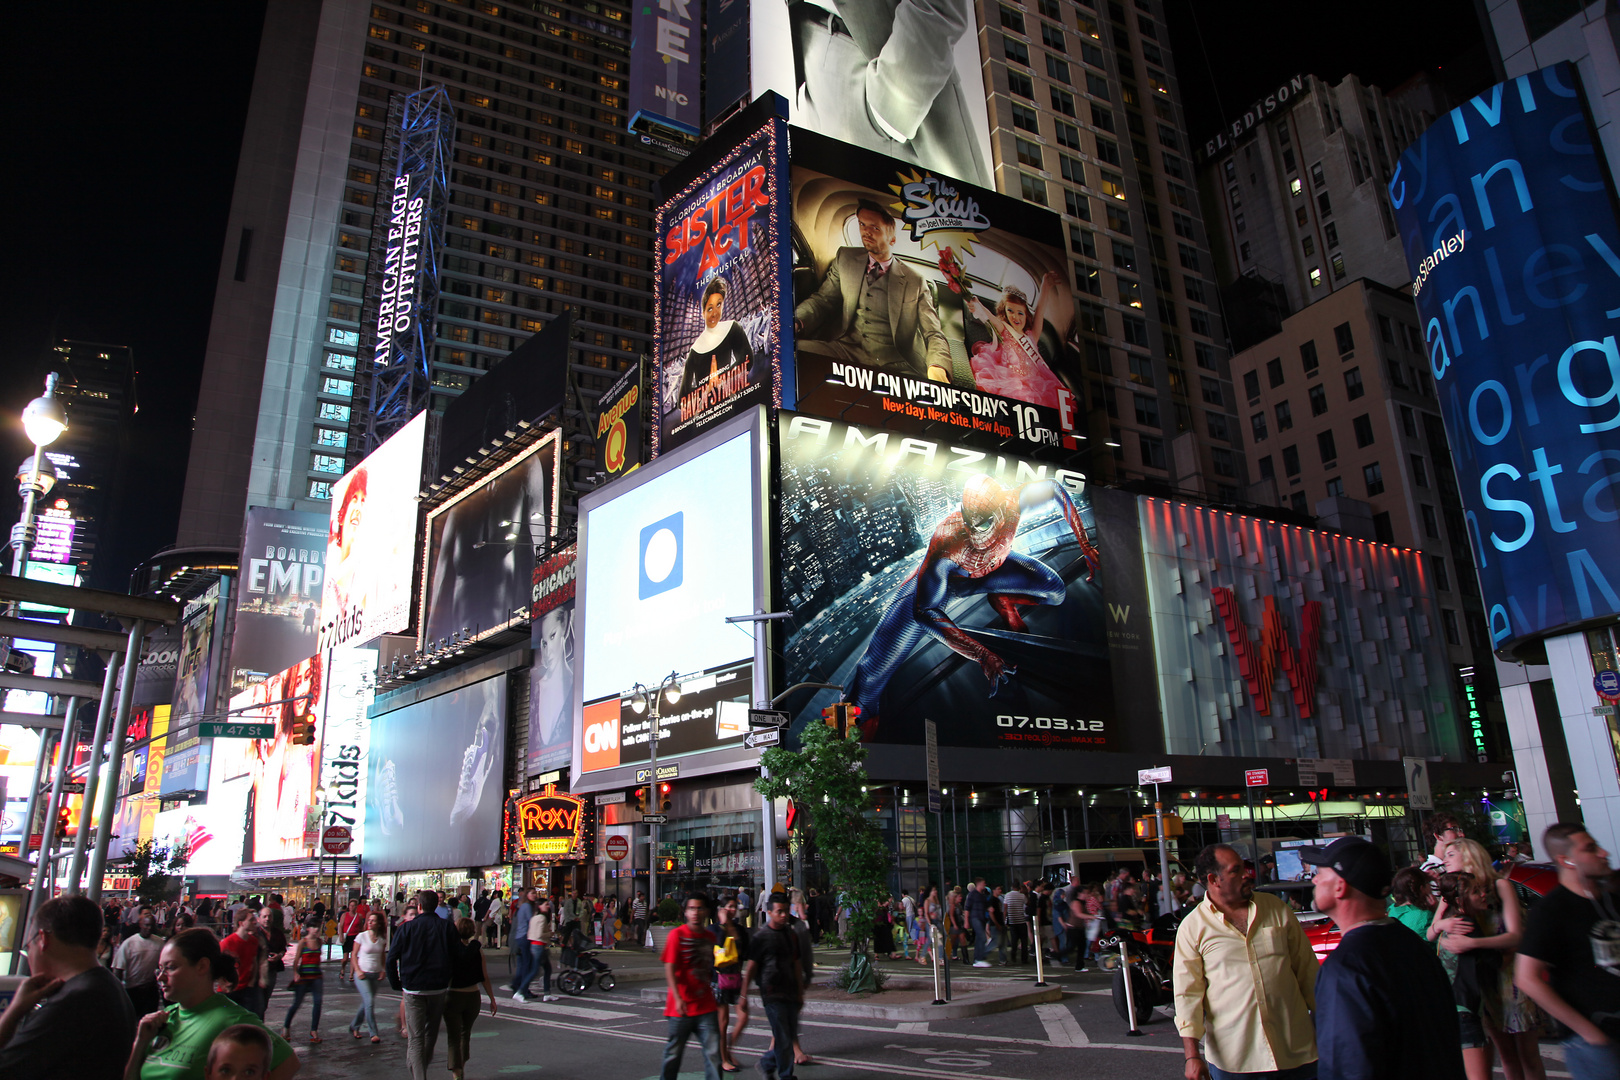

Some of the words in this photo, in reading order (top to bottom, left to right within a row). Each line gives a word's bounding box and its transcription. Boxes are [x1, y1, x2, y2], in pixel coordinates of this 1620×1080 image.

[655, 85, 689, 106] NYC
[1231, 74, 1303, 138] EDISON
[669, 185, 715, 227] GLORIOUSLY
[716, 150, 763, 191] BROADWAY
[903, 181, 982, 221] Soup
[924, 177, 958, 198] The
[664, 165, 769, 265] SISTER
[927, 218, 939, 229] Joel
[939, 218, 963, 227] McHale
[696, 204, 756, 281] ACT
[374, 246, 402, 366] AMERICAN
[388, 173, 410, 241] EAGLE
[394, 196, 424, 333] OUTFITTERS
[695, 276, 711, 289] THE
[711, 250, 750, 278] MUSICAL
[698, 375, 710, 386] NOW
[832, 361, 874, 391] NOW
[877, 372, 901, 398] ON
[903, 377, 1009, 418] WEDNESDAYS
[597, 384, 639, 439] Avenue
[882, 398, 904, 412] New
[905, 402, 927, 421] Day.
[927, 408, 949, 425] New
[949, 411, 971, 427] Site.
[972, 417, 993, 432] New
[993, 421, 1014, 437] App.
[605, 418, 625, 473] Q
[786, 415, 1087, 496] AMAZING
[532, 565, 577, 603] CHICAGO
[1108, 602, 1131, 625] W
[1121, 631, 1141, 640] YORK
[14, 656, 30, 668] WAY
[181, 647, 202, 679] UFC
[1464, 676, 1476, 710] DELI
[754, 714, 767, 723] ONE
[771, 716, 784, 724] WAY
[996, 715, 1105, 732] 07.03.12
[1468, 710, 1480, 719] &
[1594, 707, 1613, 715] TOUR
[213, 725, 223, 735] W
[227, 725, 244, 735] 47
[248, 726, 262, 736] St
[585, 718, 618, 753] CNN
[763, 732, 774, 740] WAY
[1072, 736, 1093, 744] IMAX
[1094, 737, 1106, 745] 3D
[1471, 720, 1489, 764] SALAD
[142, 745, 165, 820] Kodak
[1412, 794, 1429, 805] ONLY
[529, 842, 568, 851] DELICATESSEN
[750, 855, 761, 863] FIN
[695, 858, 711, 867] BLUE
[164, 1050, 195, 1064] 2011
